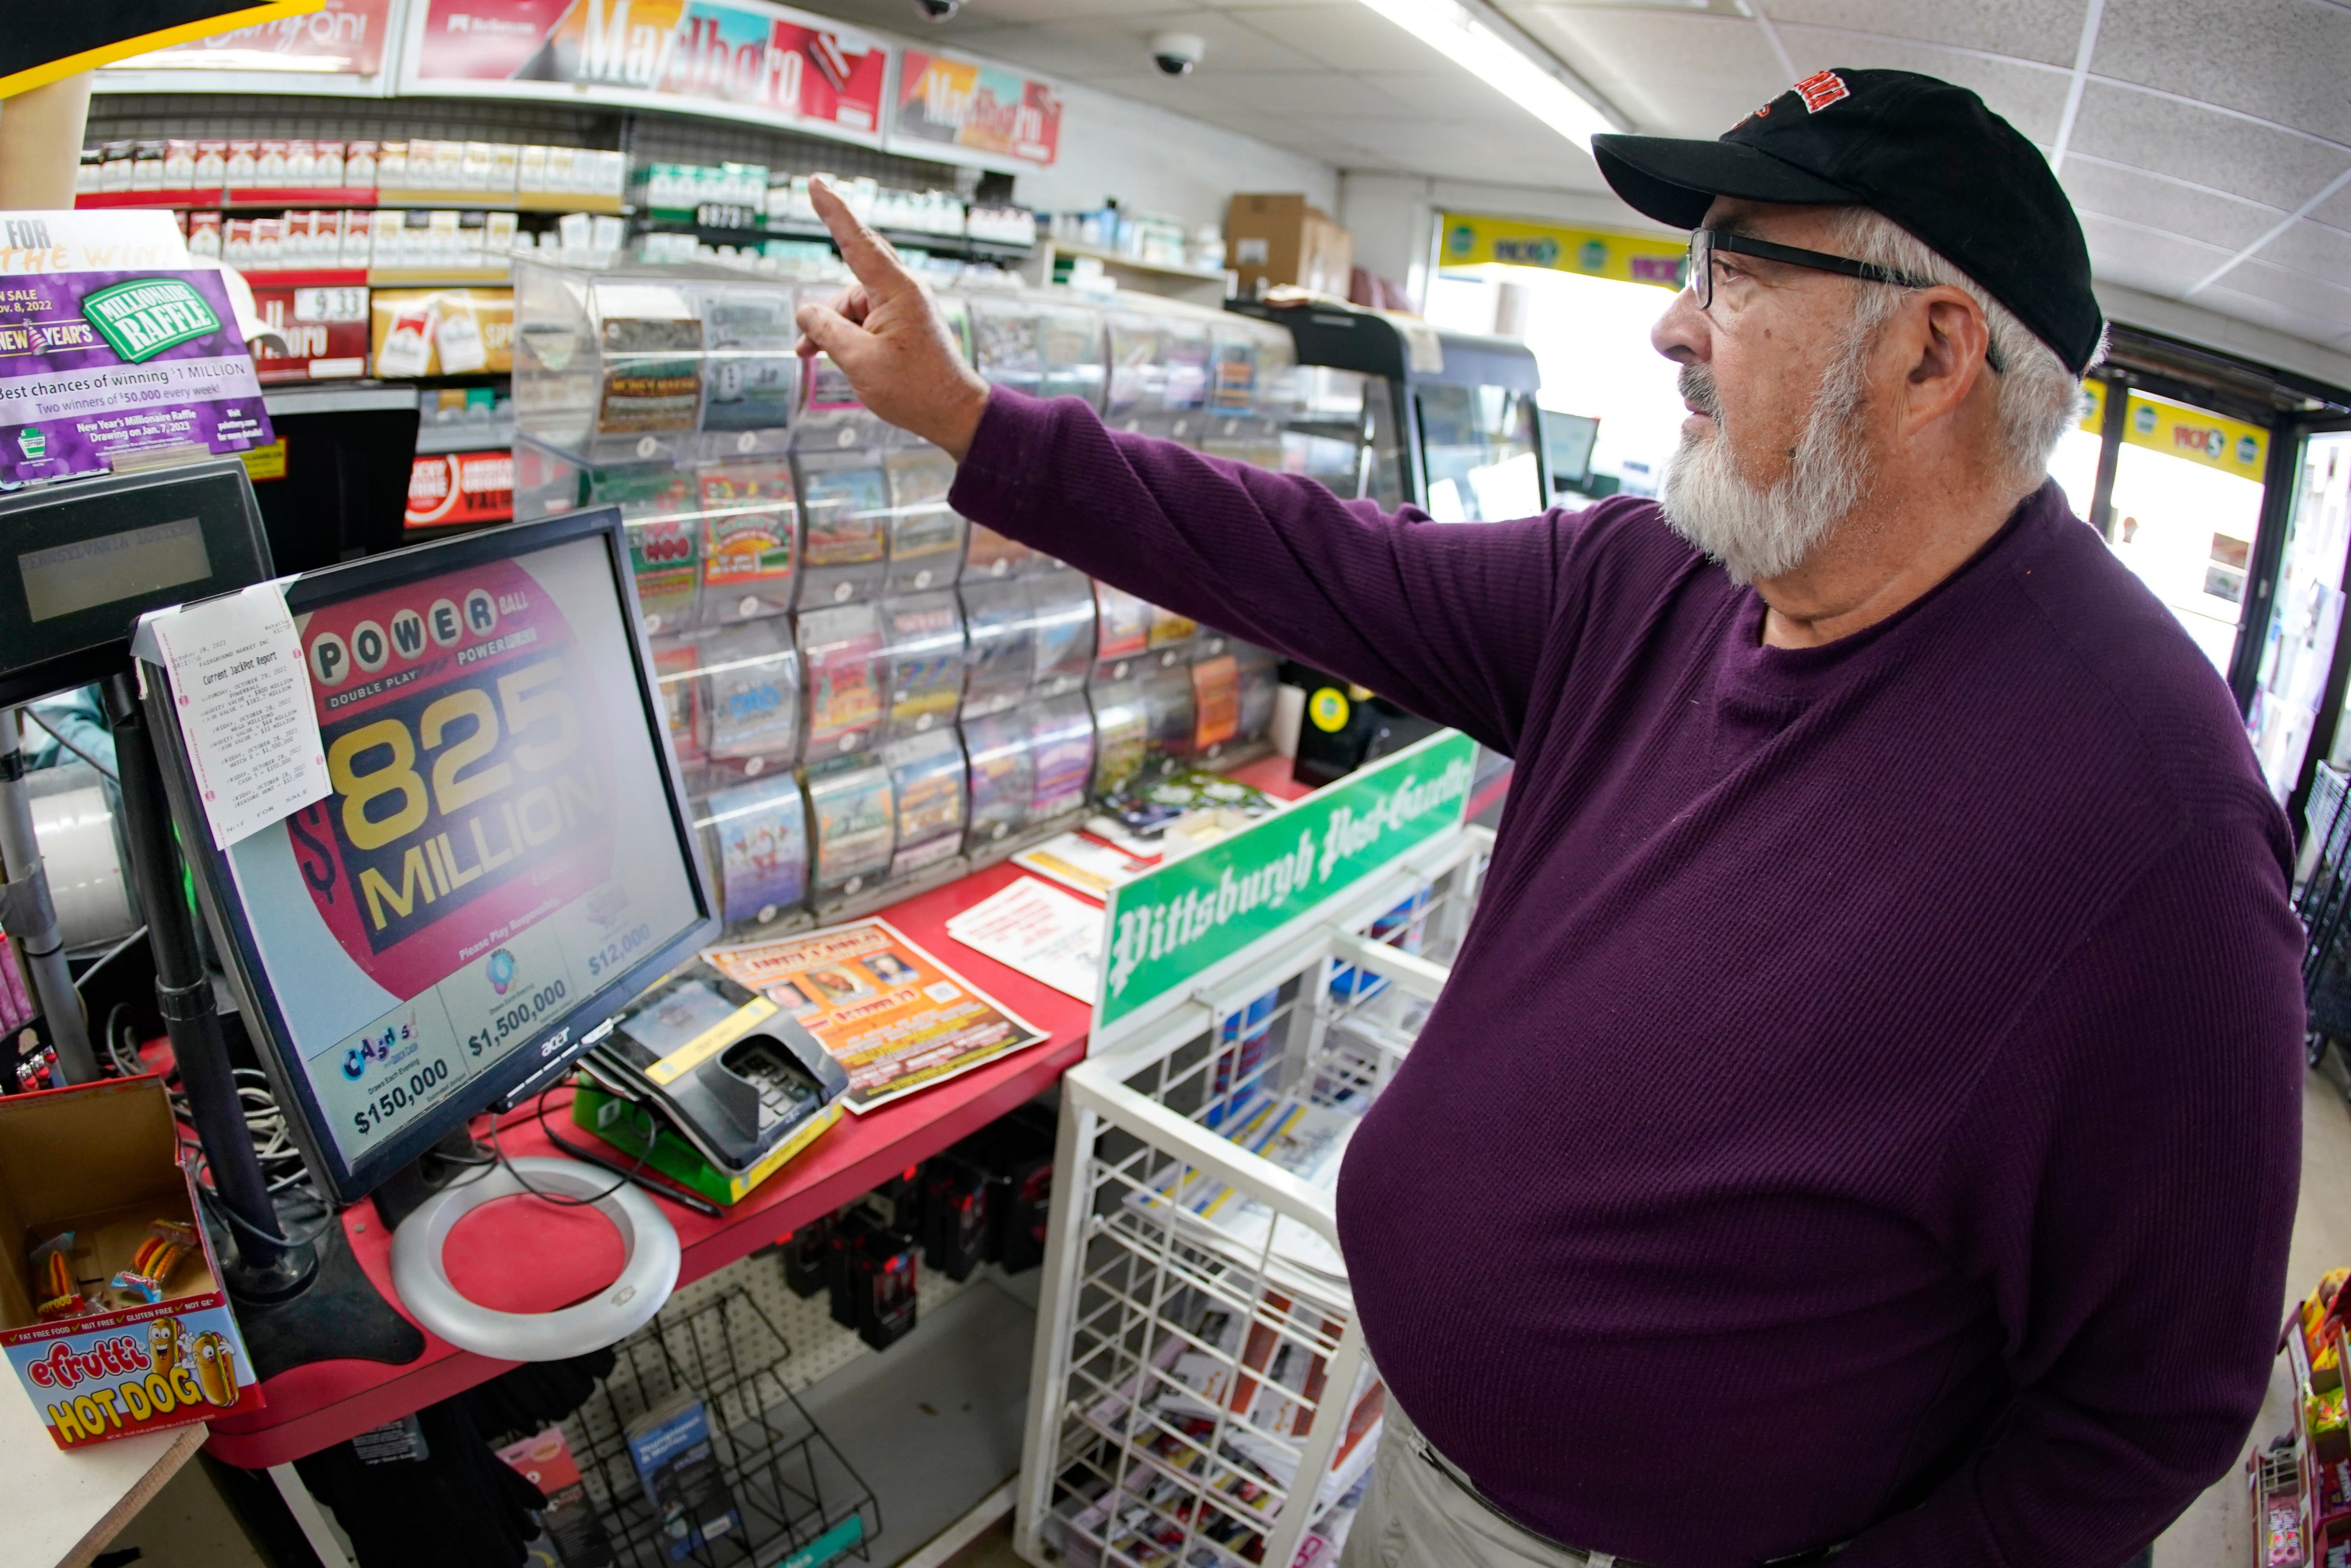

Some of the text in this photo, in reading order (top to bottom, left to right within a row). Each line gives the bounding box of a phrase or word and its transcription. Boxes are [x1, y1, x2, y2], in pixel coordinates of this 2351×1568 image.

[5, 219, 52, 250] FOR
[0, 300, 53, 313] ov. 8, 2022
[7, 289, 37, 301] SALE
[96, 283, 196, 322] MILLIONAIRE
[42, 324, 94, 346] YEAR'S
[114, 298, 212, 353] RAFFLE
[31, 380, 94, 397] chances
[94, 375, 108, 388] of
[111, 370, 170, 386] winning
[188, 363, 245, 379] MILLION
[36, 384, 220, 415] Two winners of $50,000 every week!
[76, 409, 197, 434] New Year's Millionaire Raffle
[90, 430, 128, 443] Drawing
[128, 429, 141, 438] on
[142, 424, 160, 437] Jan.
[171, 422, 190, 433] 2023
[21, 538, 129, 572] PENNSYLVANIA
[212, 639, 227, 649] 2022
[313, 593, 495, 682] POWER
[498, 590, 528, 616] BALL
[199, 639, 271, 668] FAIRGROUND MARKET INC
[203, 651, 278, 686] Current JackPot Report
[227, 695, 245, 706] VALUE
[270, 677, 294, 690] MILLION
[229, 684, 260, 699] POWERBALL
[234, 677, 258, 690] OCTOBER
[329, 670, 418, 708] DOUBLE PLAY
[219, 706, 237, 717] VALUE
[268, 685, 292, 697] MILLION
[239, 709, 263, 722] OCTOBER
[230, 711, 274, 733] MEGA MILLIONS
[234, 734, 252, 745] VALUE
[272, 716, 296, 729] MILLION
[236, 726, 253, 737] VALUE
[274, 708, 298, 722] MILLION
[247, 739, 271, 753] OCTOBER
[229, 757, 247, 768] MATCH
[252, 759, 275, 772] OCTOBER
[238, 776, 252, 786] CASH
[256, 776, 280, 791] OCTOBER
[261, 785, 275, 796] HUNT
[256, 805, 275, 818] FOR
[285, 788, 309, 804] SALE
[359, 775, 606, 930] MILLION
[1109, 828, 1317, 999] Pittsburgh
[458, 938, 489, 961] Please
[489, 926, 509, 942] Play
[588, 923, 650, 976] $12,000
[468, 979, 566, 1057] $1,500,000
[343, 1027, 396, 1079] CASH
[541, 1026, 570, 1057] acer
[368, 1058, 420, 1095] Draws Each Evening
[354, 1059, 448, 1134] $150,000
[32, 1329, 51, 1339] FREE
[51, 1326, 70, 1336] FOOD
[81, 1322, 96, 1330] NUT
[97, 1318, 115, 1328] FREE
[126, 1312, 154, 1322] GLUTEN
[155, 1307, 174, 1317] FREE
[185, 1301, 199, 1311] NOT
[30, 1337, 151, 1389] efrutti
[47, 1388, 123, 1444] HOT
[119, 1367, 203, 1422] DOG
